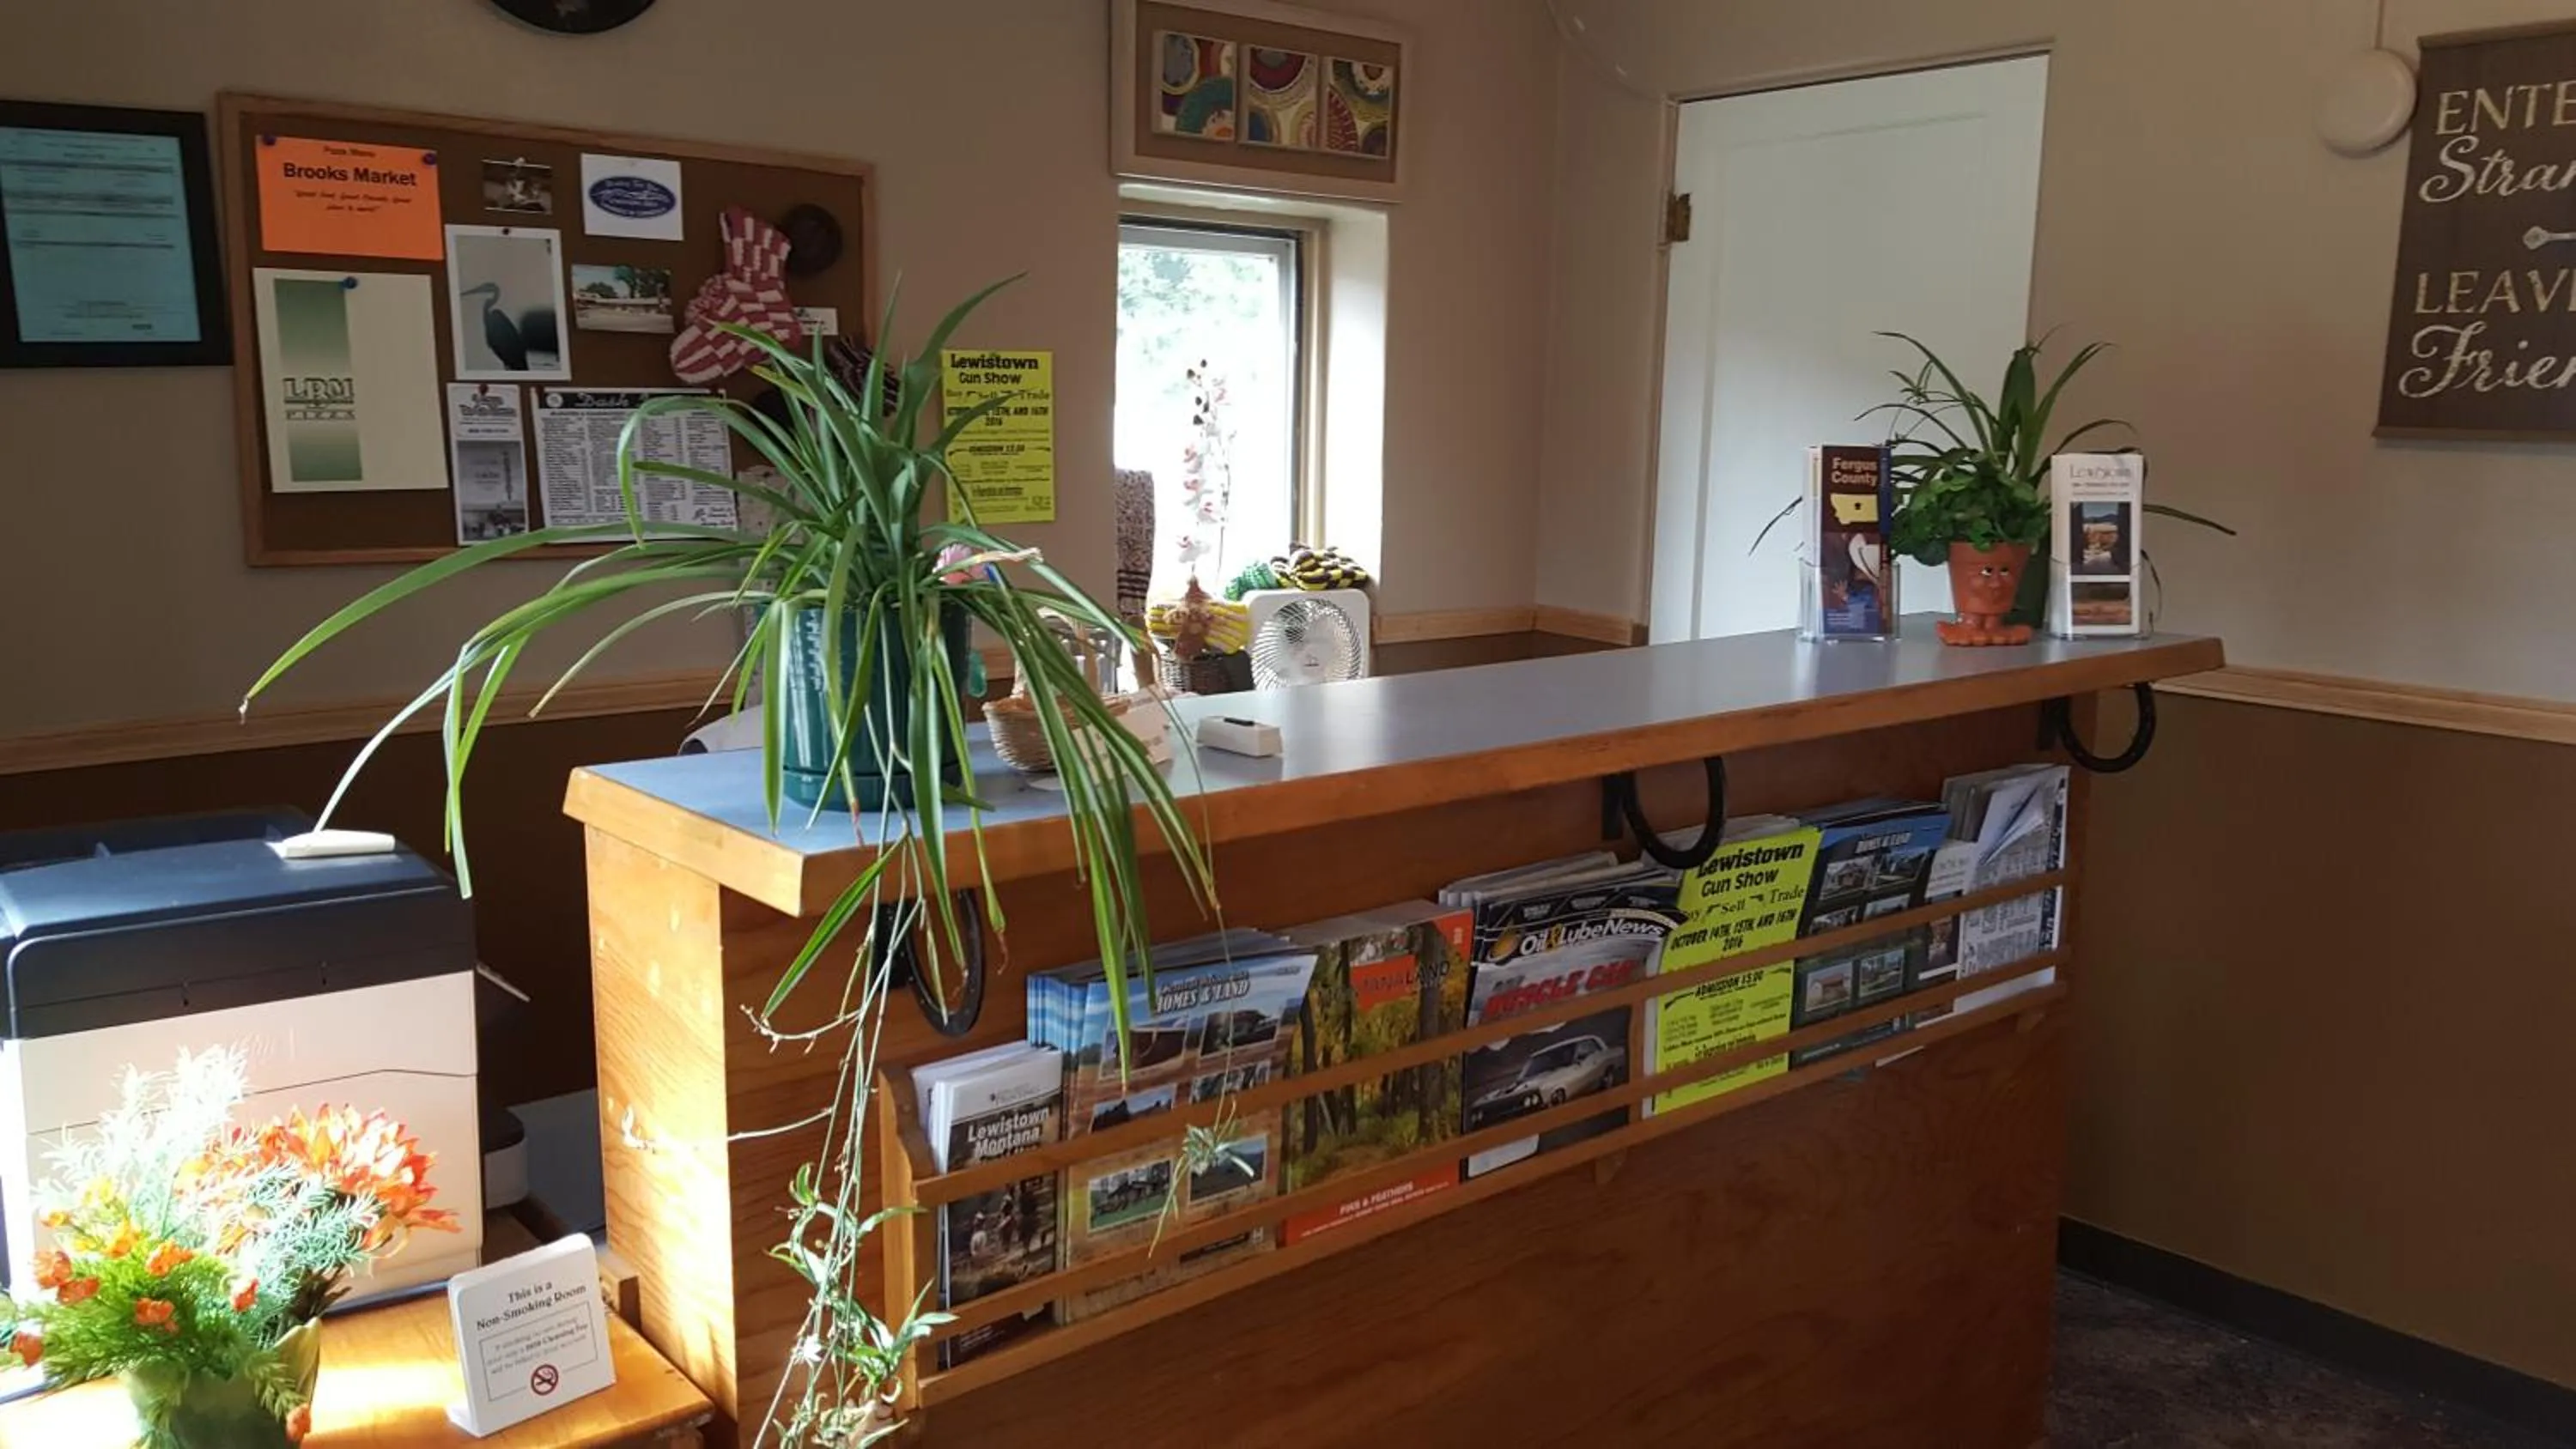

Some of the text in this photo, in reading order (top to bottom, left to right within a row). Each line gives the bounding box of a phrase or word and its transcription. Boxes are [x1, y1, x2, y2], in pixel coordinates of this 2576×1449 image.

[283, 162, 417, 187] Brooks Market
[951, 353, 1039, 369] Lewistown
[959, 372, 1022, 385] Gun Show
[1832, 457, 1878, 473] Fergus
[1831, 471, 1878, 487] County
[1697, 844, 1805, 878] Lewistown
[1701, 869, 1780, 897] Gun Show
[1769, 885, 1806, 904] Trade
[968, 1106, 1050, 1143] Lewistown
[974, 1125, 1041, 1158] Montana
[507, 1282, 553, 1304] This is a
[477, 1284, 587, 1331] Non-Smoking Room
